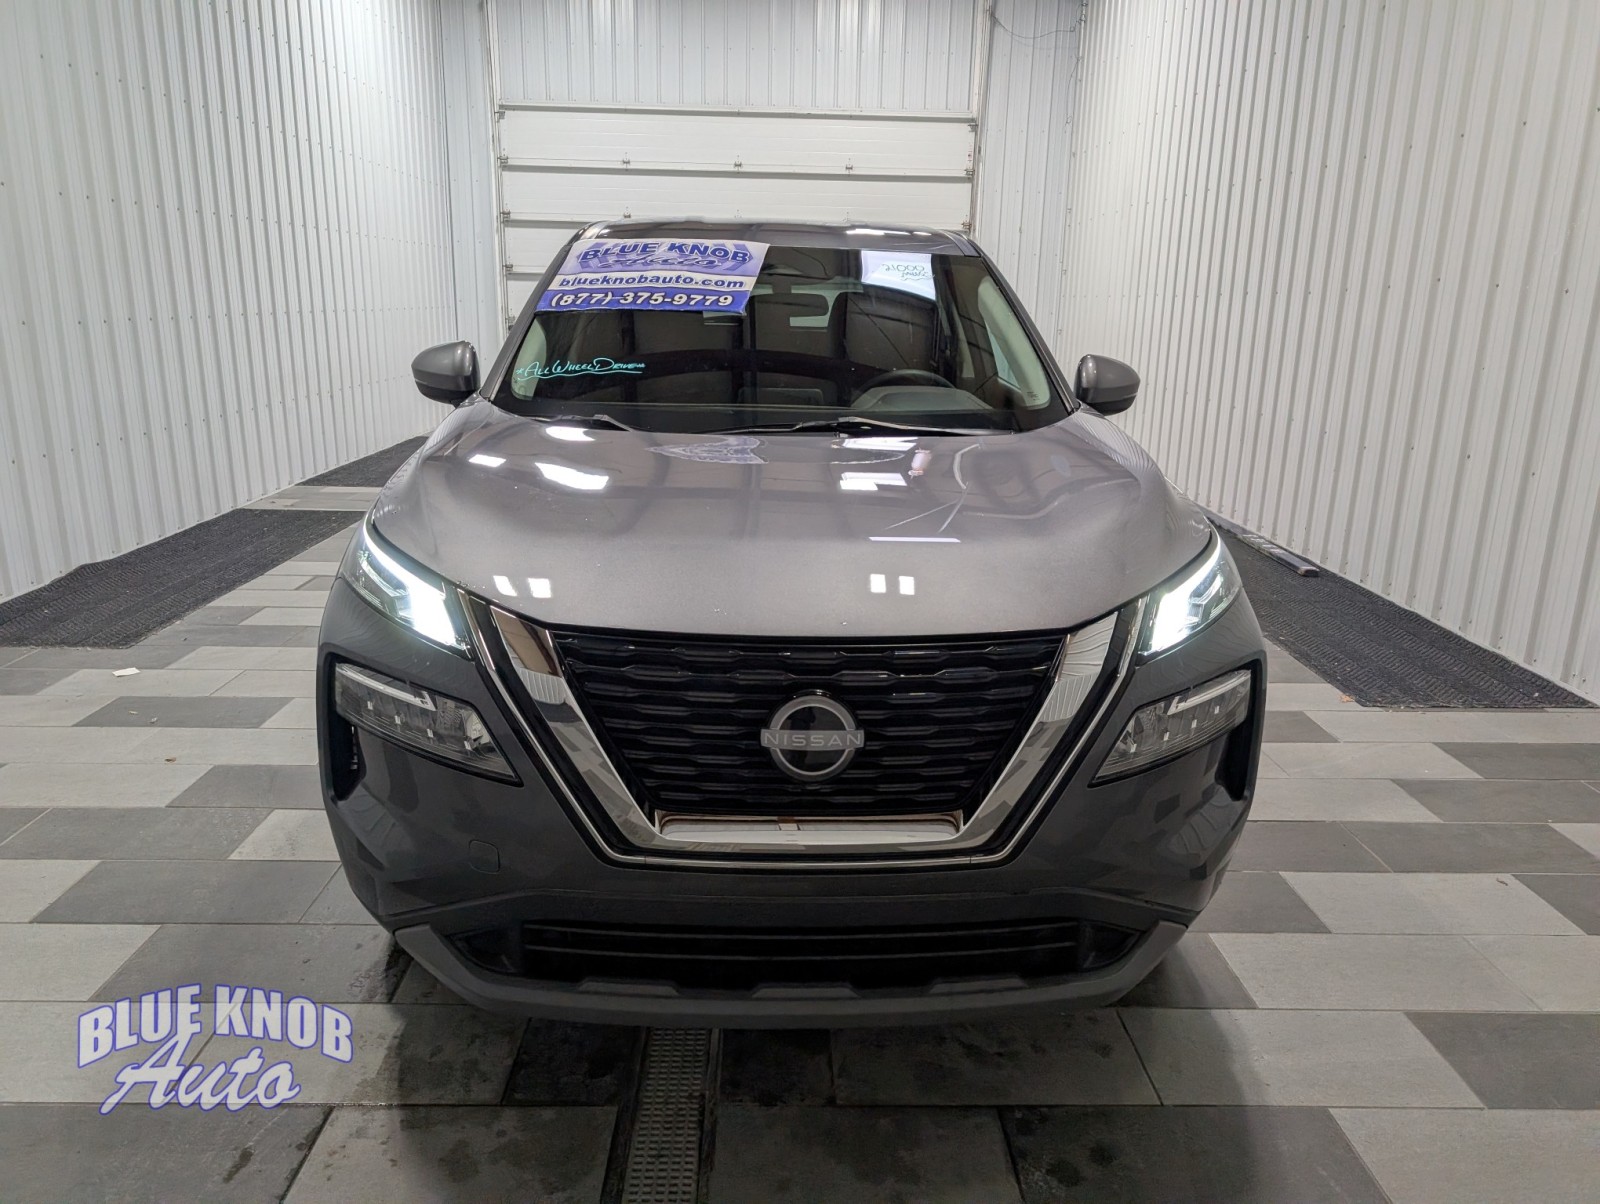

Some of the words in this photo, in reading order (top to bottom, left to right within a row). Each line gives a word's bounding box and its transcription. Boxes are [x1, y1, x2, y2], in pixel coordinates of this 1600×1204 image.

[579, 242, 658, 262] BLUE
[668, 242, 750, 264] KNOB
[598, 253, 722, 268] Auto
[558, 274, 745, 288] blueknobauto.com
[551, 292, 613, 307] (877)
[619, 292, 733, 306] 375-9779
[764, 732, 861, 747] NISSAN
